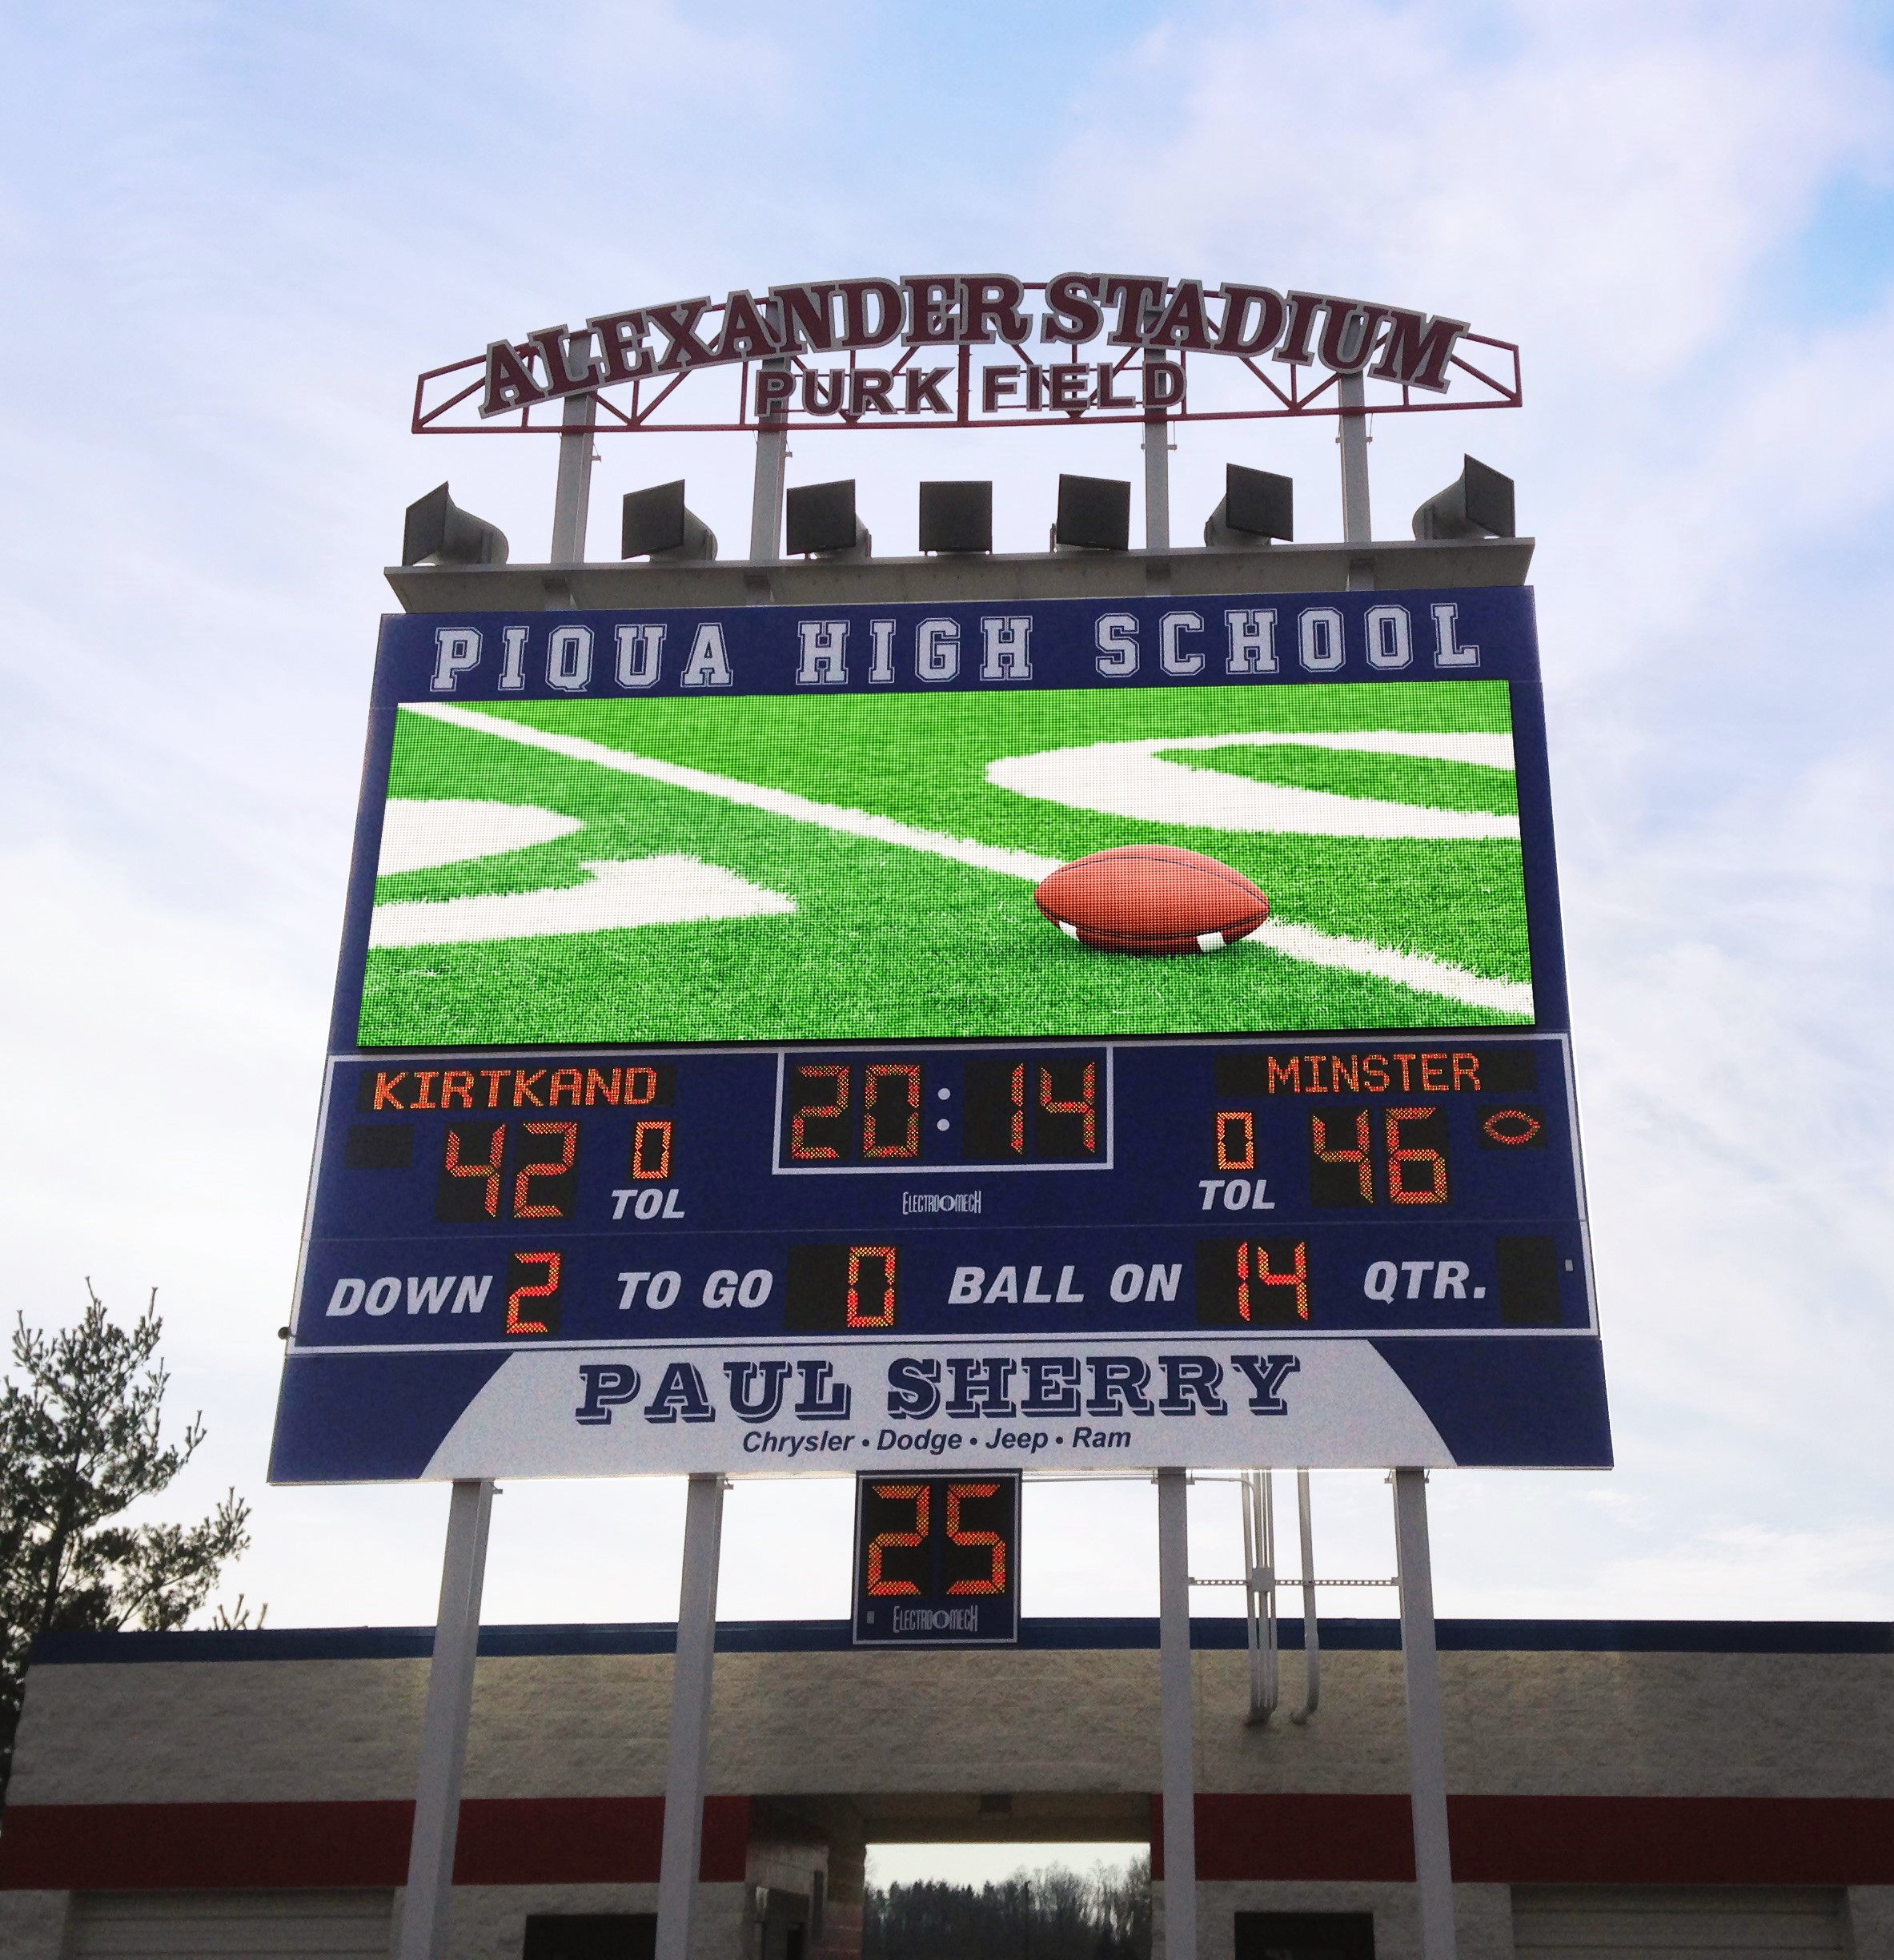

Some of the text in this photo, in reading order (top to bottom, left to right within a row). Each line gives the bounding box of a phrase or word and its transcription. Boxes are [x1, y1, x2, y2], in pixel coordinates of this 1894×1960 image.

[479, 272, 1471, 418] ALEXANDER STADIUM
[755, 361, 1186, 416] PURK FIELD
[430, 603, 1480, 692] PIQUA HIGH SCHOOL
[373, 1067, 657, 1110] KIRTKAND
[1267, 1053, 1482, 1094] MINSTER
[632, 1121, 672, 1179] 0
[1216, 1111, 1254, 1171] 0
[1311, 1107, 1449, 1204] 46
[445, 1123, 578, 1219] 42
[1198, 1179, 1276, 1211] TOL
[611, 1188, 685, 1220] TOL
[325, 1275, 494, 1317] DOWN
[506, 1252, 561, 1334] 2
[616, 1268, 774, 1311] TO GO
[846, 1246, 897, 1327] 0
[947, 1263, 1183, 1304] BALL ON
[1237, 1241, 1309, 1321] 14
[1362, 1260, 1487, 1304] QTR.
[575, 1353, 1302, 1426] PAUL SHERRY
[742, 1427, 1132, 1456] Chrysler Dodge Jeep Ram
[867, 1484, 1006, 1596] 25
